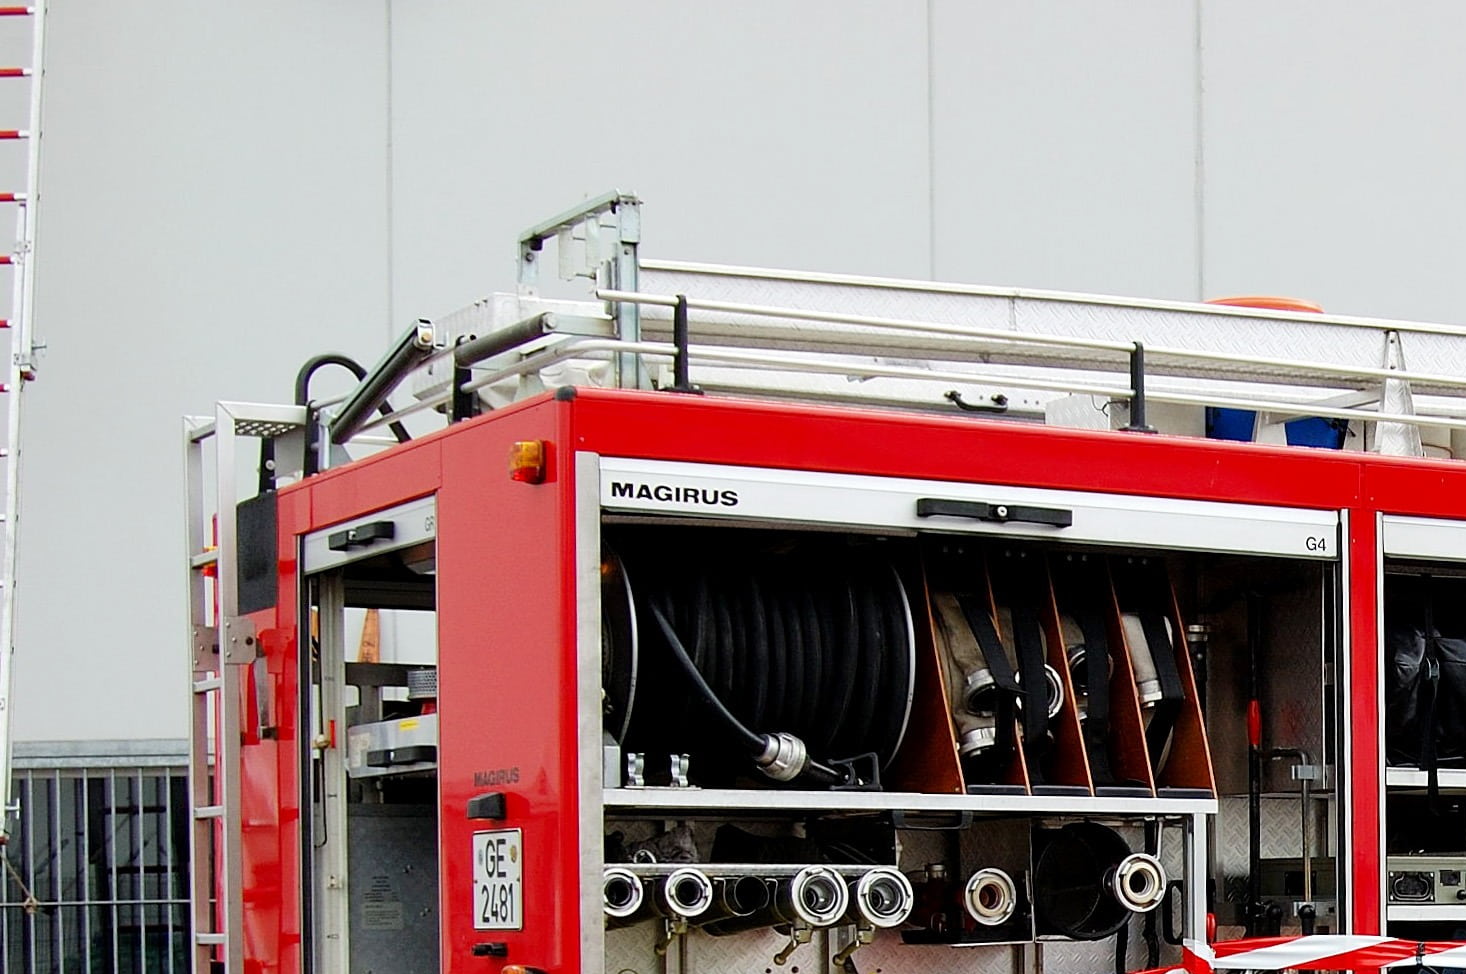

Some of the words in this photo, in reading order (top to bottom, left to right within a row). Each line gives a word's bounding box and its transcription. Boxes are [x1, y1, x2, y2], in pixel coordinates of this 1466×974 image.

[611, 481, 739, 507] MAGIRUS
[1306, 536, 1326, 551] G4
[473, 767, 520, 788] MAGIRUS
[485, 838, 507, 879] GE
[481, 882, 514, 924] 2481
